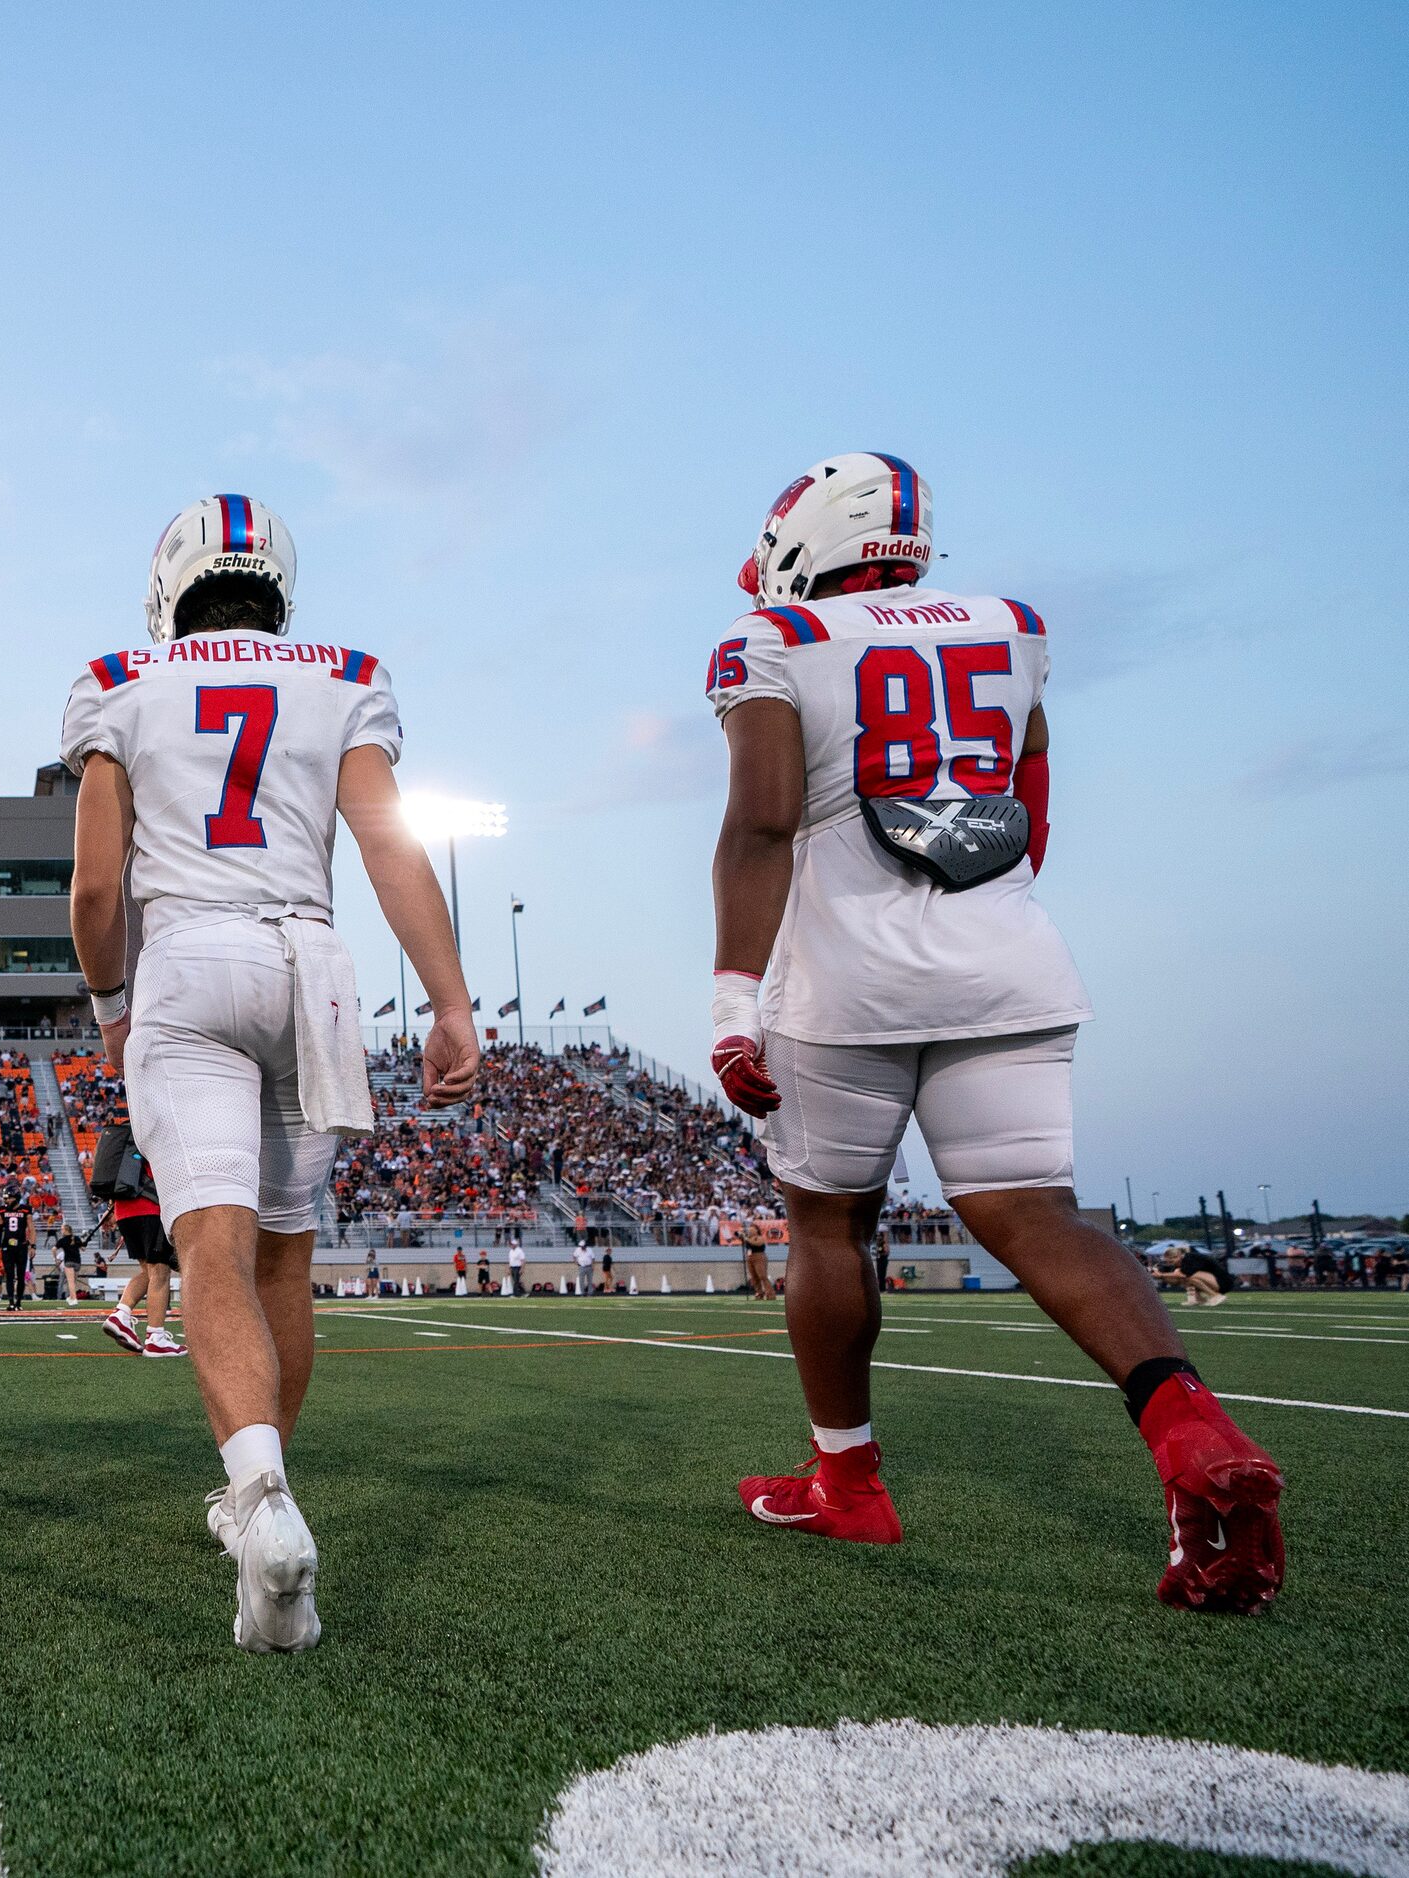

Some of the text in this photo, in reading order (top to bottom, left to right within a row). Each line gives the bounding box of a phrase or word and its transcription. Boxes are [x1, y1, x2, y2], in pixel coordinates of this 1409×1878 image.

[259, 538, 267, 550] 7
[861, 540, 931, 562] Riddell
[212, 553, 266, 571] schutt
[132, 639, 340, 665] S. ANDERSON
[853, 641, 1014, 800] 85
[195, 683, 279, 850] 7
